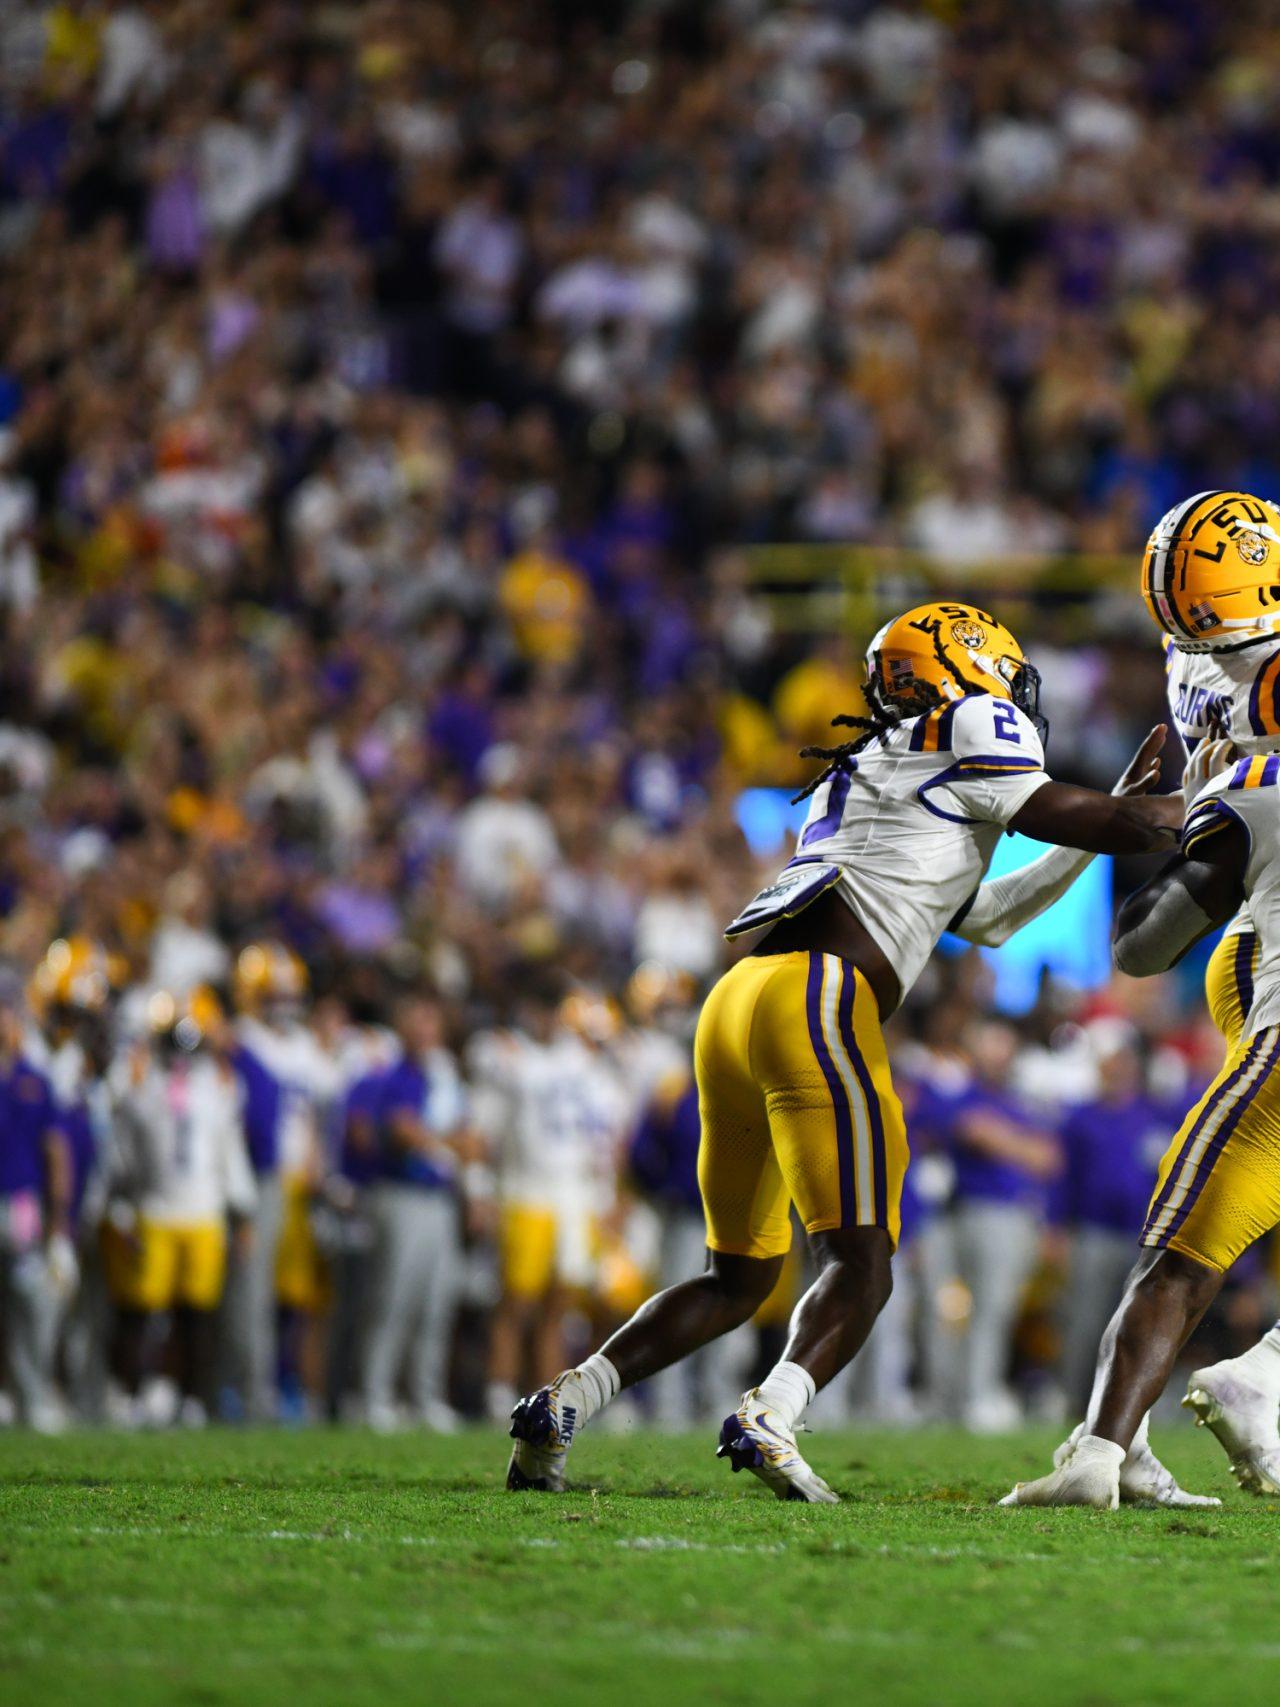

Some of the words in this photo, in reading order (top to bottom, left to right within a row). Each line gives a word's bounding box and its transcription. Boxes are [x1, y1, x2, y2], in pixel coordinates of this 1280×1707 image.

[1194, 502, 1268, 563] LSU
[993, 701, 1021, 744] 2
[560, 1406, 577, 1444] NIKE
